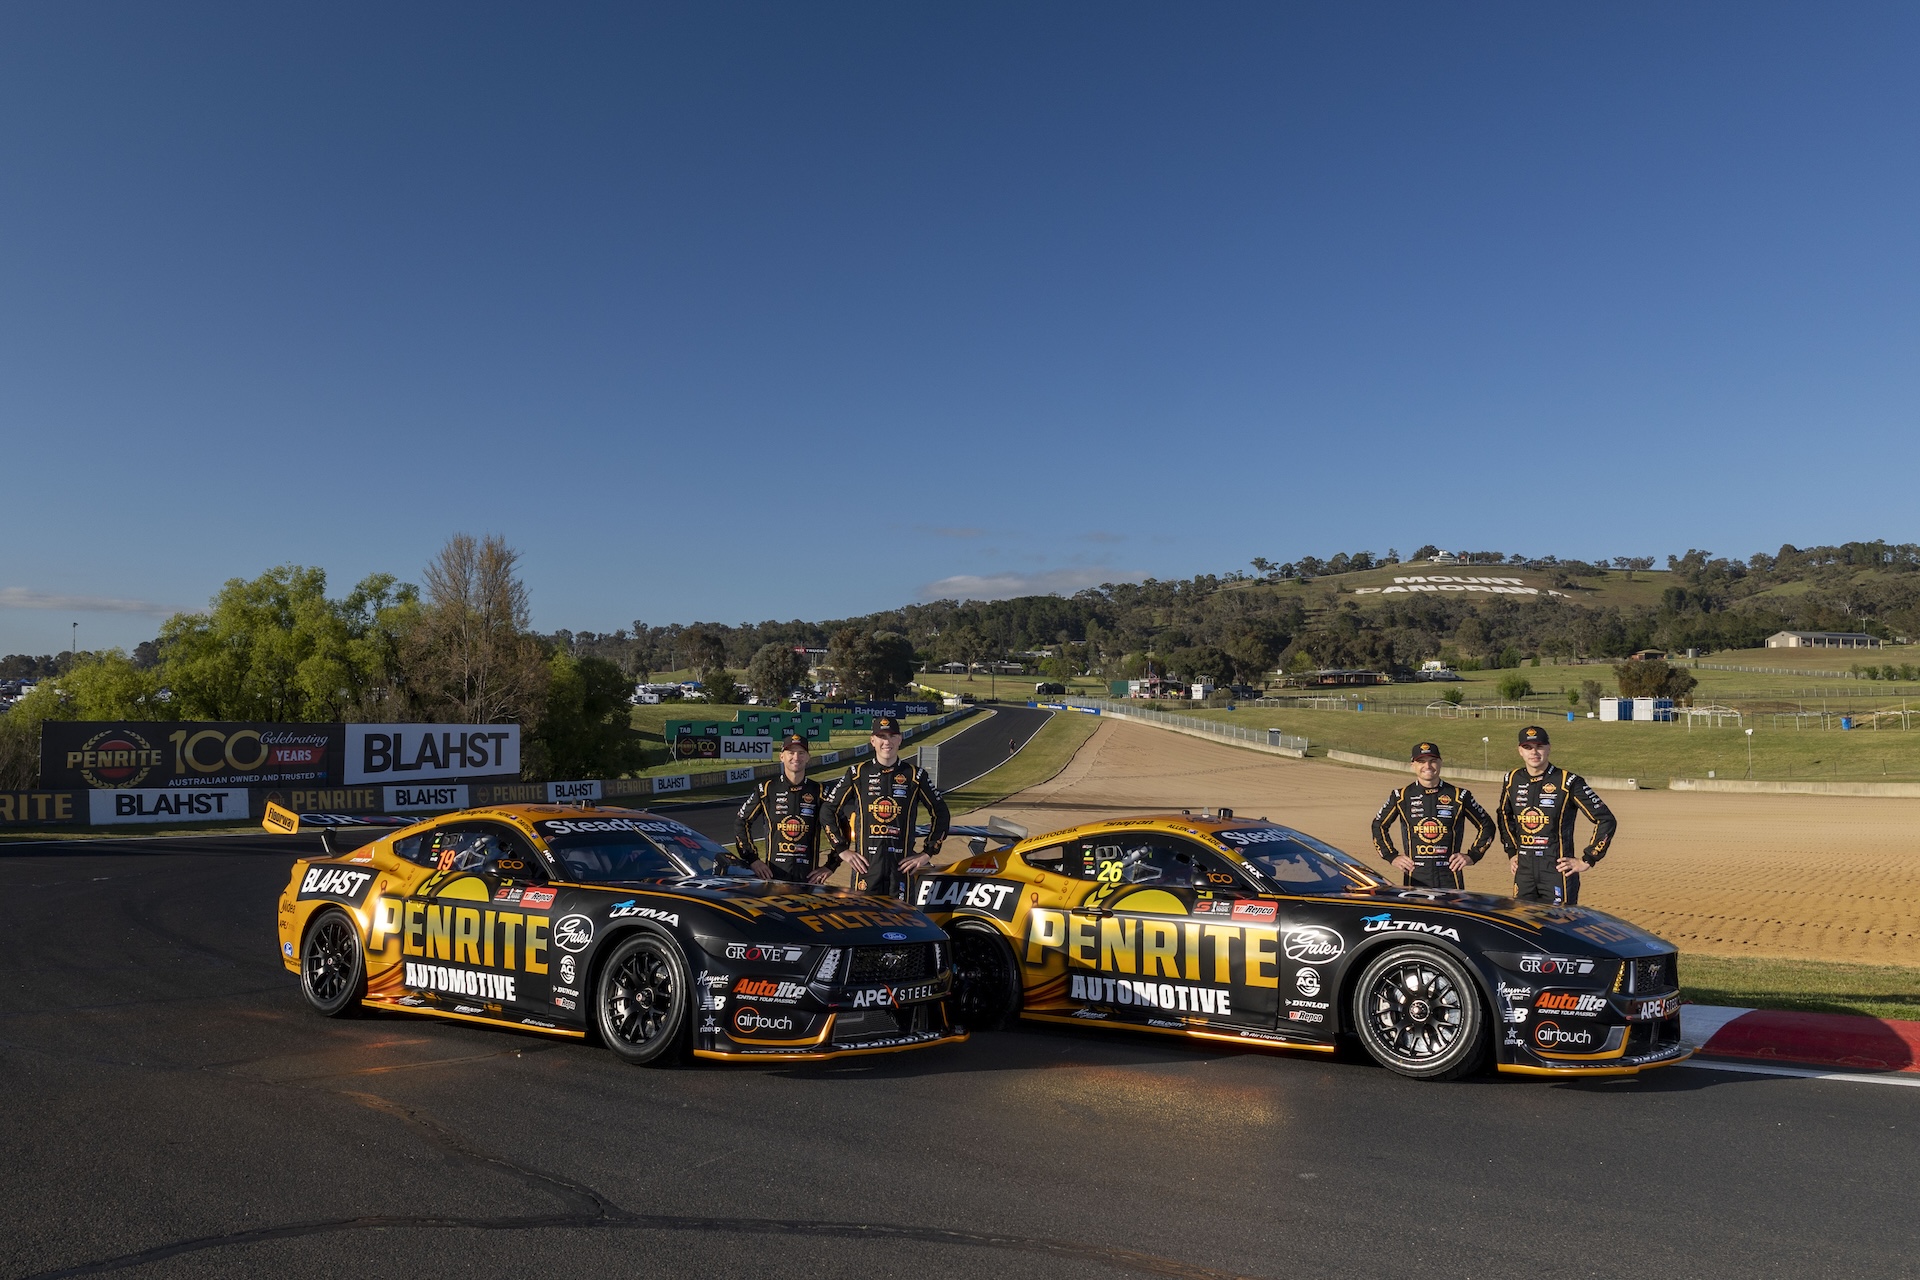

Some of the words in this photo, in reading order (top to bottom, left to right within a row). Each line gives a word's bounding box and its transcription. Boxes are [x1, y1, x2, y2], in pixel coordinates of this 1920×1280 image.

[1393, 576, 1523, 586] MOUNT
[855, 706, 897, 717] Batteries
[259, 731, 329, 747] Celebrating
[782, 728, 794, 736] TAB
[808, 728, 818, 736] TAB
[169, 730, 269, 774] 100
[363, 732, 509, 774] BLAHST
[724, 742, 771, 753] BLAHST
[66, 750, 162, 769] PENRITE
[276, 750, 312, 762] YEARS
[168, 776, 228, 787] AUSTRALIAN
[229, 774, 260, 783] OWNED
[261, 773, 279, 782] AND
[280, 772, 315, 780] TRUSTED
[116, 792, 228, 816] BLAHST
[291, 788, 375, 811] PENRITE
[395, 788, 457, 805] BLAHST
[493, 784, 543, 802] PENRITE
[555, 783, 594, 798] BLAHST
[616, 779, 650, 794] PENRITE
[658, 777, 685, 790] BLAHST
[730, 769, 750, 781] BLAHST
[868, 804, 902, 815] PENRITE
[268, 807, 296, 829] Floorway
[1517, 815, 1549, 824] PENRITE
[544, 818, 672, 835] Steadfast
[777, 822, 809, 833] PENRITE
[869, 824, 888, 835] 100
[1167, 824, 1189, 832] ALLEN
[1413, 826, 1448, 834] PENRITE
[674, 836, 702, 850] 19
[1033, 827, 1079, 843] AUTODESK
[1200, 833, 1220, 846] SLADE
[1520, 834, 1535, 845] 100
[777, 842, 797, 853] 100
[1416, 845, 1435, 855] 100
[437, 850, 456, 871] 19
[497, 859, 524, 870] 100
[1097, 860, 1124, 882] 26
[1241, 861, 1264, 879] HRX
[301, 868, 371, 897] BLAHST
[1206, 873, 1233, 884] 100
[531, 891, 553, 902] Repco
[916, 880, 1015, 910] BLAHST
[609, 906, 679, 928] ULTIMA
[1245, 904, 1275, 916] Repco
[797, 911, 927, 932] FILTERS
[369, 897, 550, 975] PENRITE
[555, 917, 593, 950] Gates
[1363, 919, 1461, 943] ULTIMA
[1026, 909, 1279, 989] PENRITE
[1285, 928, 1343, 961] Gates
[725, 946, 780, 962] GROVE
[560, 964, 575, 976] ACL
[1519, 959, 1575, 975] GROVE
[405, 962, 517, 1001] AUTOMOTIVE
[697, 970, 729, 988] Haymes
[1296, 977, 1321, 988] ACL
[557, 986, 579, 998] DUNLOP
[732, 978, 806, 998] Autolite
[1071, 974, 1231, 1016] AUTOMOTIVE
[1497, 981, 1531, 999] Haymes
[561, 997, 577, 1010] Repco
[853, 984, 899, 1009] APEX
[900, 985, 933, 1001] STEEL
[1292, 999, 1329, 1010] DUNLOP
[1534, 992, 1607, 1012] Autolite
[1299, 1011, 1324, 1023] Repco
[1641, 999, 1669, 1020] APEX
[700, 1025, 721, 1034] rizeup
[737, 1014, 792, 1030] airtouch
[1504, 1037, 1524, 1047] rizeup
[1537, 1028, 1591, 1044] airtouch
